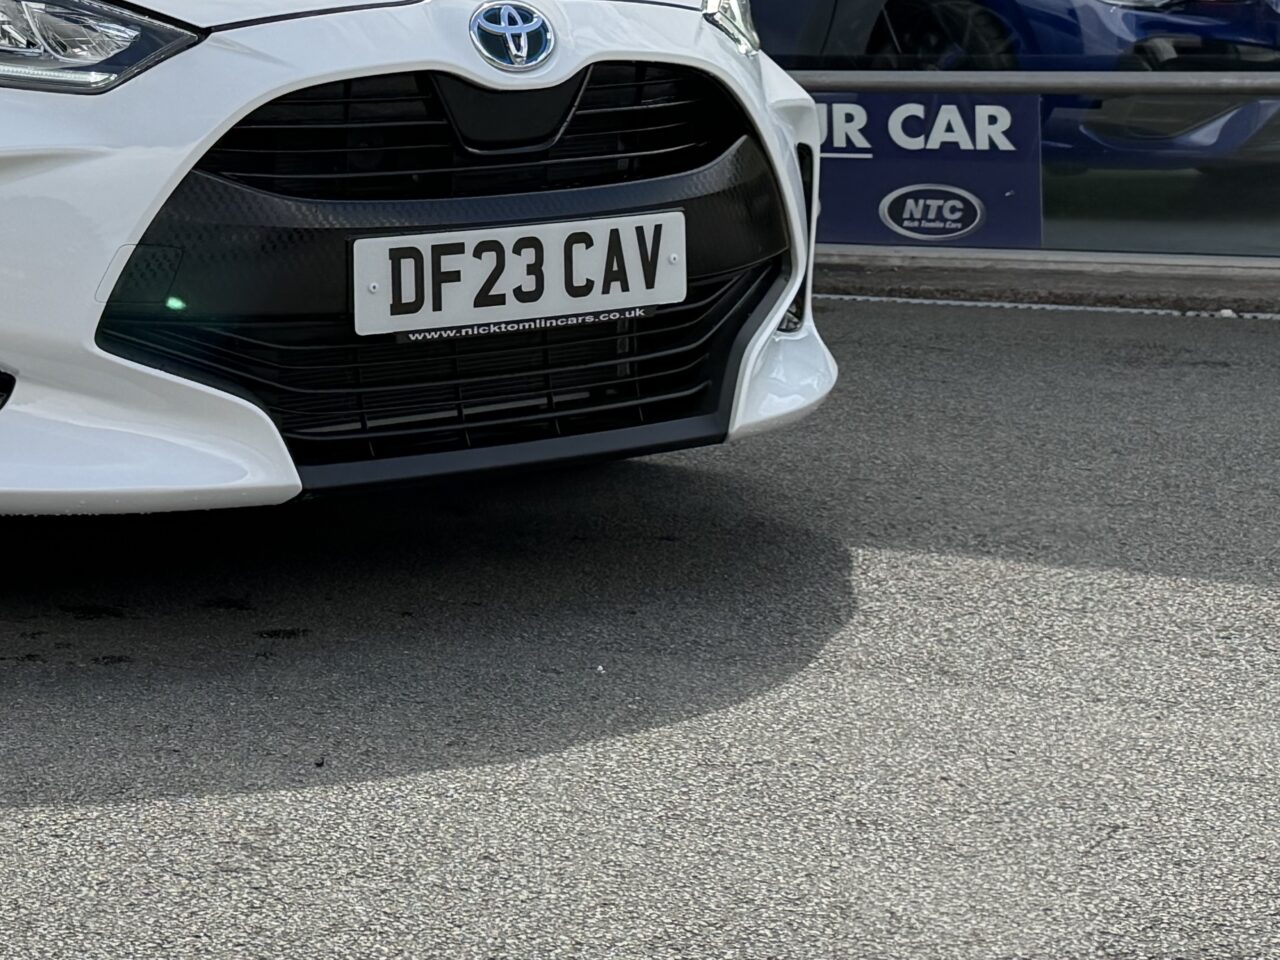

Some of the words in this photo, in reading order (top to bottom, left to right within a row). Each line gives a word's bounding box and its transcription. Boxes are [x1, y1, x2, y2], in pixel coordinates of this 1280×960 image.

[887, 103, 1016, 150] CAR
[902, 199, 965, 221] NTC
[388, 236, 545, 316] DF23
[563, 223, 663, 298] CAV
[408, 308, 645, 341] www.nicktomlincars.co.uk
